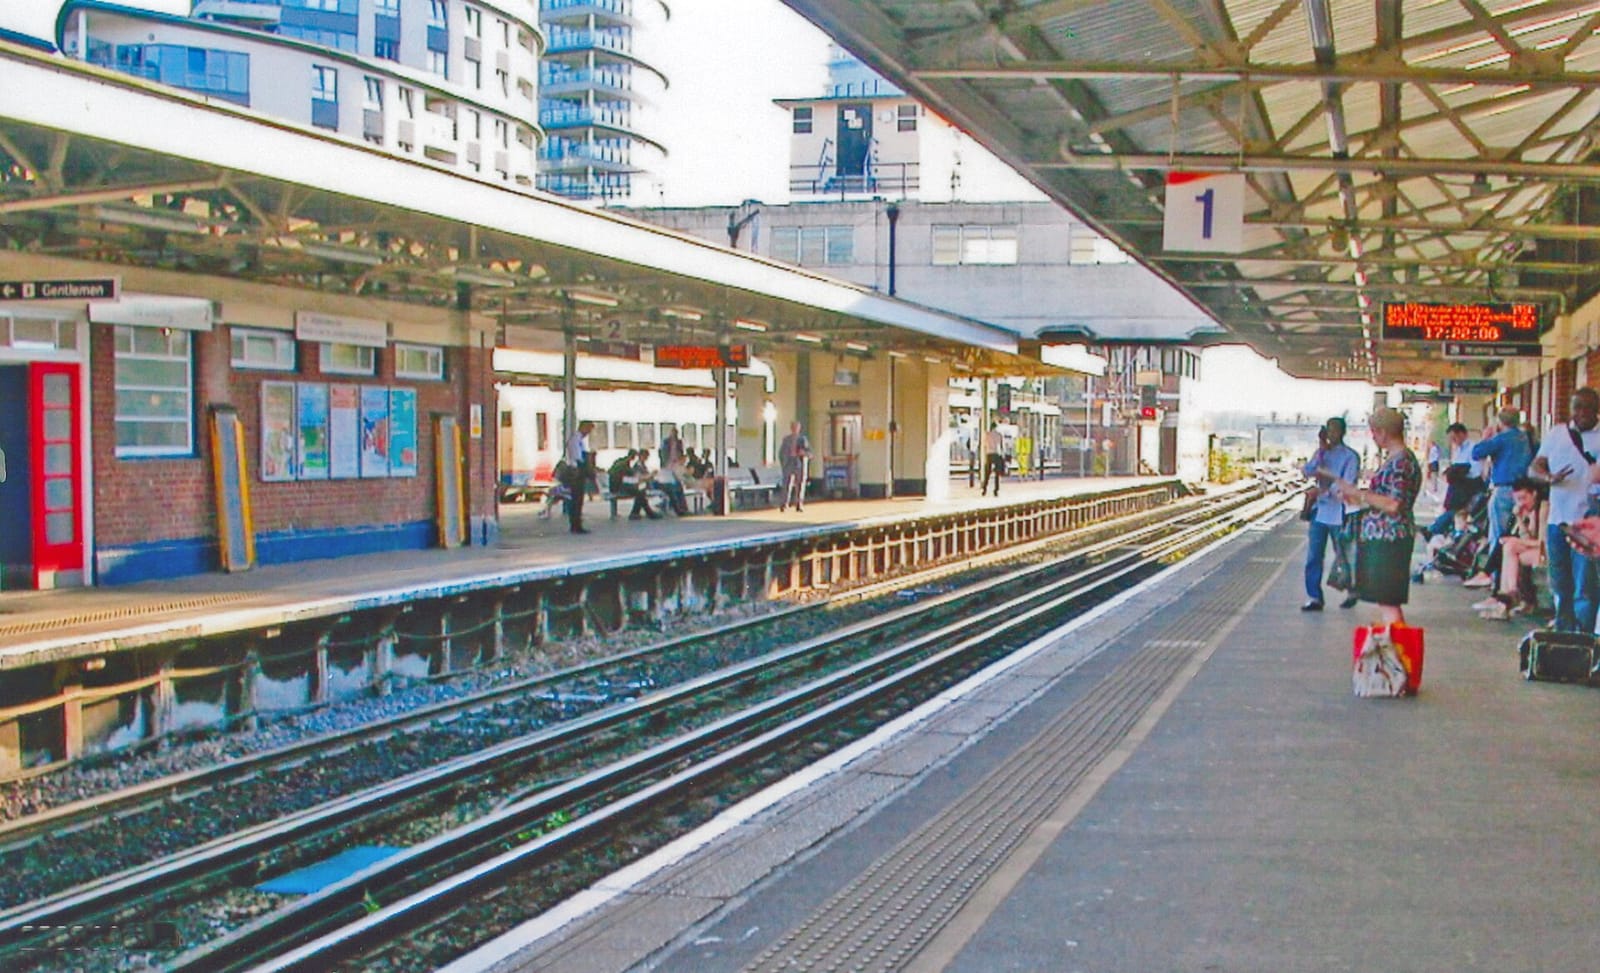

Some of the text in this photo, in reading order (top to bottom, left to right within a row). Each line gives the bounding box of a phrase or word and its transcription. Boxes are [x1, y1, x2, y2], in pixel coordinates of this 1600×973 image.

[1195, 188, 1213, 239] 1
[41, 283, 104, 297] Gentlemen
[607, 319, 621, 339] 2
